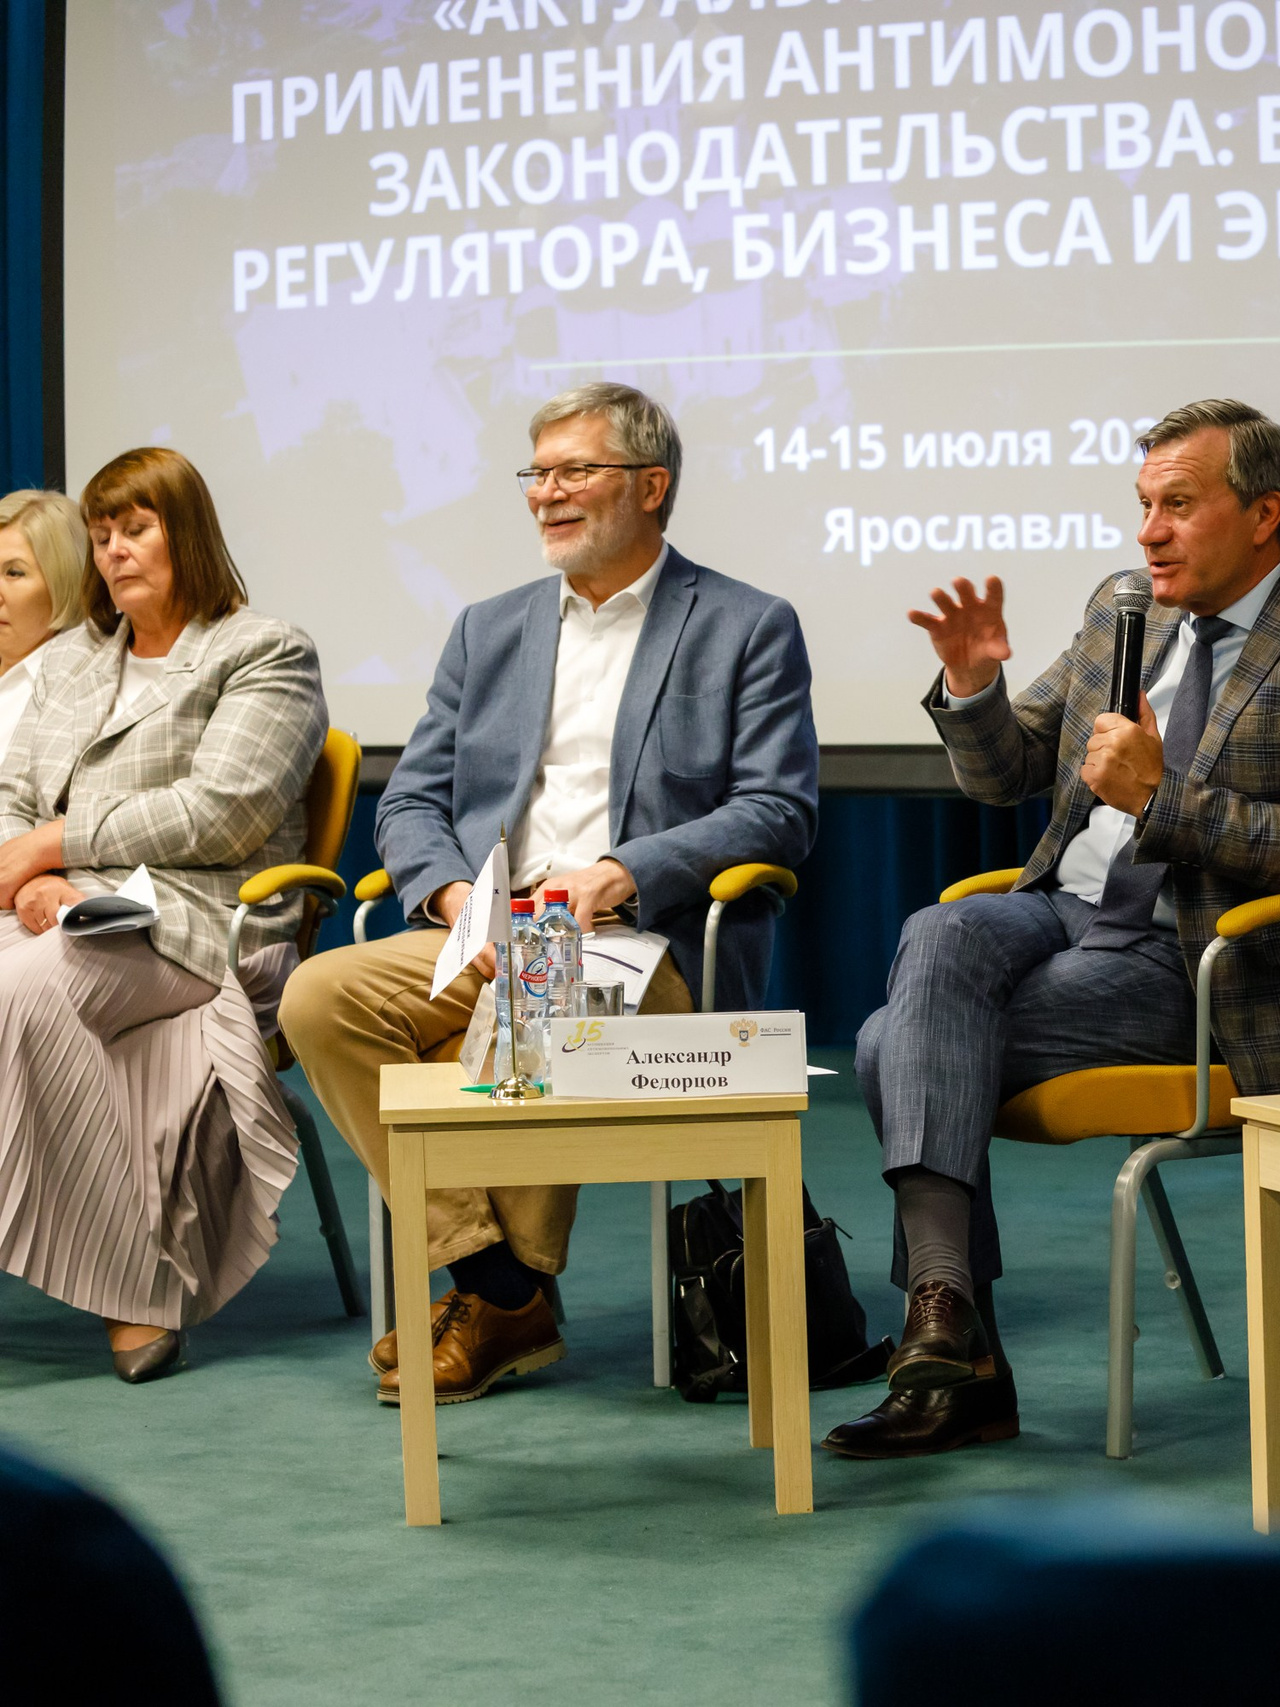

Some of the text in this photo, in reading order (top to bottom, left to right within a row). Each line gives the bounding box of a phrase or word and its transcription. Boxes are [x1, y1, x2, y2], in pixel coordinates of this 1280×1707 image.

[232, 36, 744, 144] ПРИМЕНЕНИЯ
[369, 112, 1234, 217] ЗАКОНОДАТЕЛЬСТВА:
[233, 213, 709, 313] РЕГУЛЯТОРА,
[733, 193, 1112, 280] БИЗНЕСА
[1133, 193, 1192, 264] И
[754, 424, 886, 473] 14-15
[904, 430, 1052, 469] июля
[822, 507, 1123, 566] Ярославль
[572, 1020, 606, 1043] 15
[626, 1049, 732, 1067] Александр
[631, 1074, 729, 1093] Федорцов
